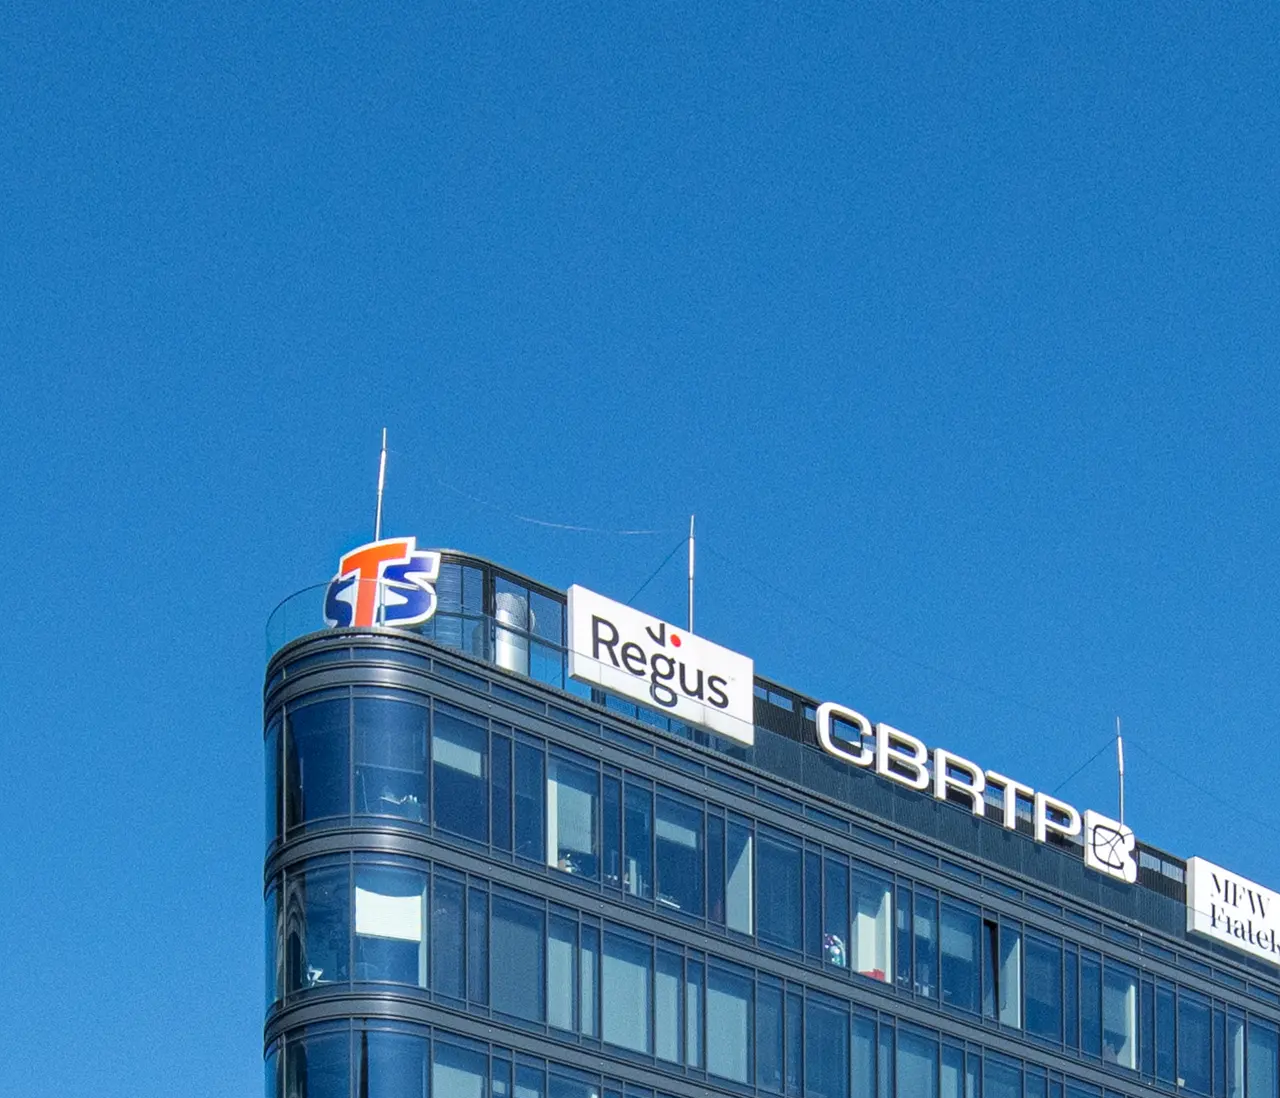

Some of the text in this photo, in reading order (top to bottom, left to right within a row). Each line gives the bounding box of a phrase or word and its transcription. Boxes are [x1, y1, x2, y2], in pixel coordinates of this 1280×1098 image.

[323, 537, 440, 627] STS
[591, 614, 730, 709] Regus
[816, 702, 1082, 843] CBRTP
[1210, 872, 1271, 919] MFW
